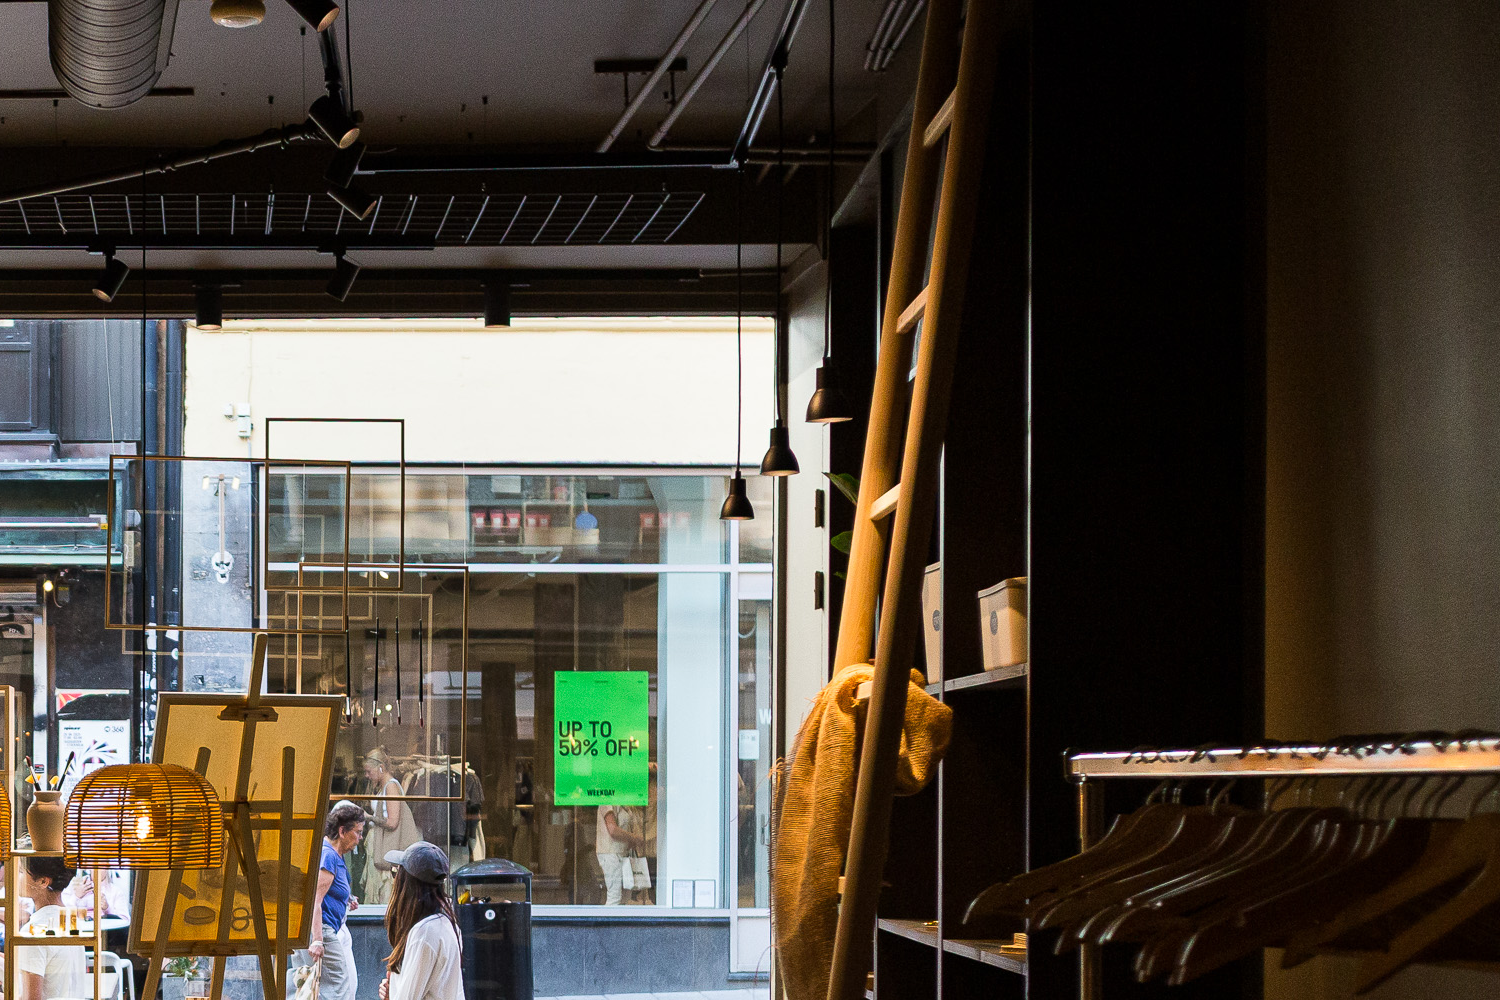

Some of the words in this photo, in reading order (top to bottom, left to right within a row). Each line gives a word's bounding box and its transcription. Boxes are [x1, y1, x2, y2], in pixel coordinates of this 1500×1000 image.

[559, 721, 583, 738] UP
[589, 721, 612, 738] TO
[559, 739, 599, 756] 50%
[605, 739, 639, 756] OFF
[586, 789, 616, 797] WEEKDAY
